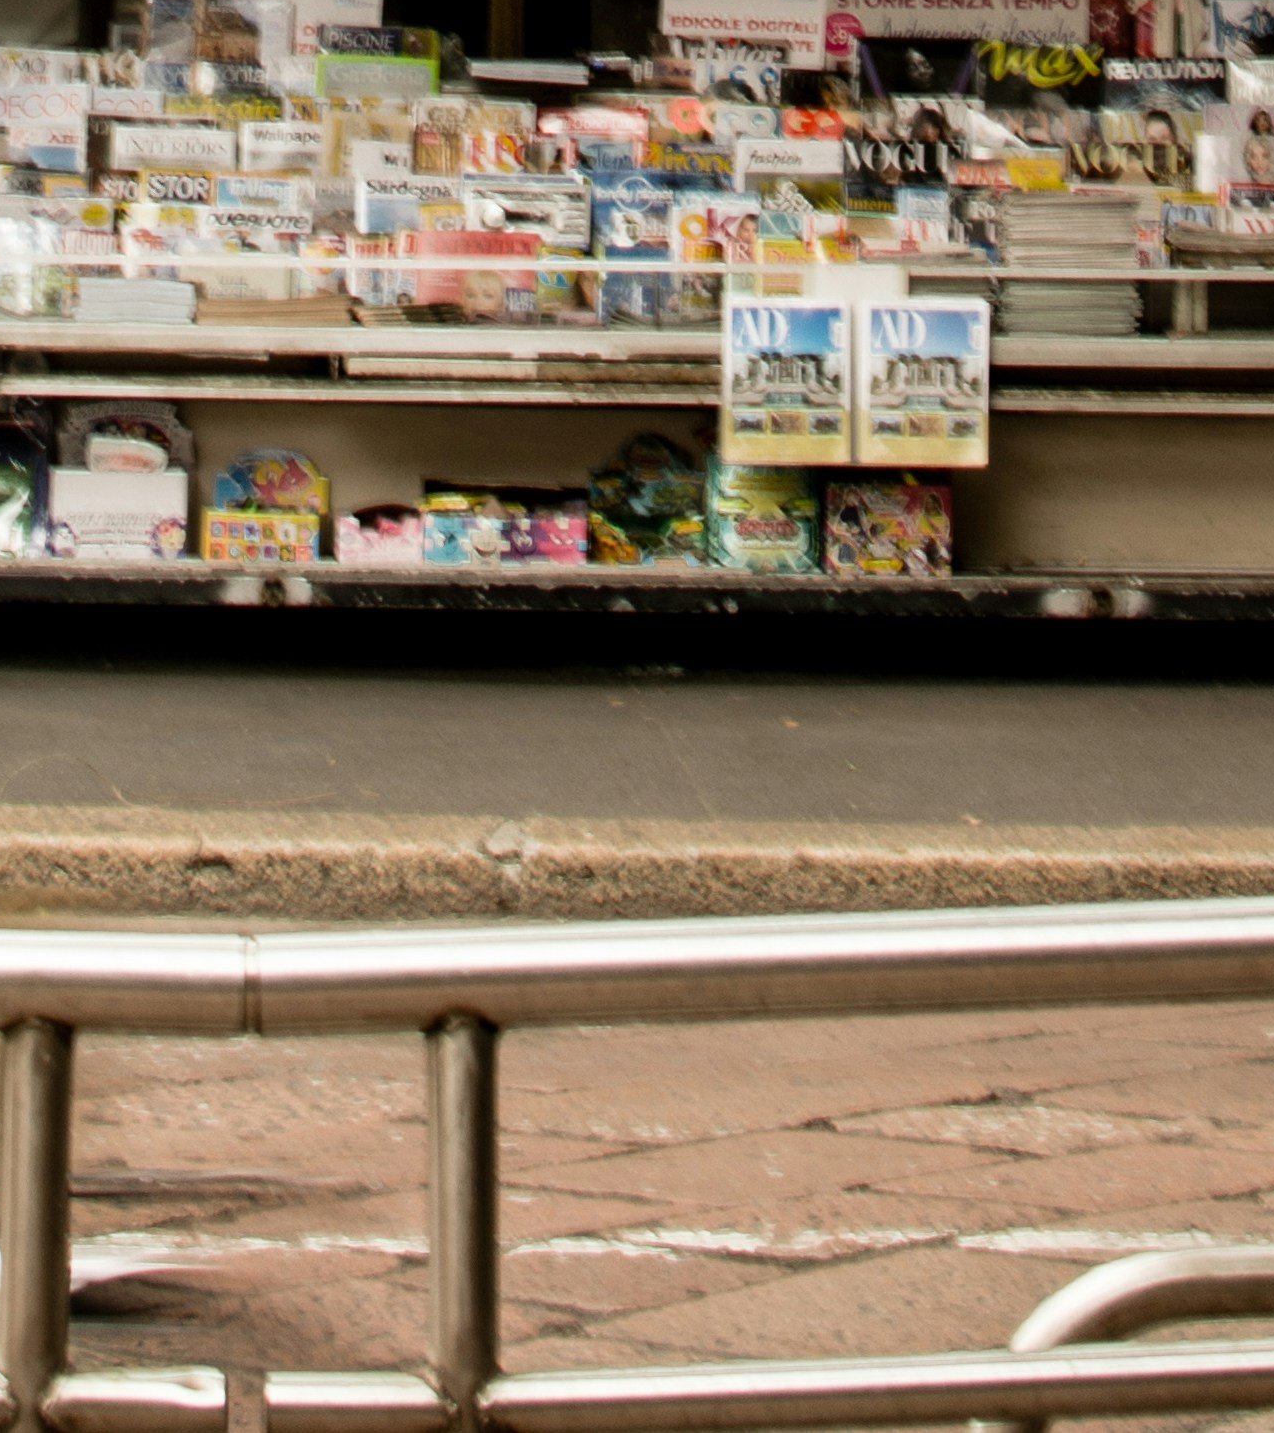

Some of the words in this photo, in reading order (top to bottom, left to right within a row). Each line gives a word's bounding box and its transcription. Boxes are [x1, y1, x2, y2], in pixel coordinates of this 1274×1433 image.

[671, 13, 743, 32] EDICOLE
[747, 17, 819, 35] DIGITALI
[328, 29, 395, 50] PISCINE
[1105, 62, 1224, 81] REVOLUTION
[253, 129, 321, 146] Wallpape
[125, 138, 229, 158] INTERIORS
[749, 152, 803, 167] fashion
[735, 308, 789, 348] AD
[877, 309, 927, 349] AD
